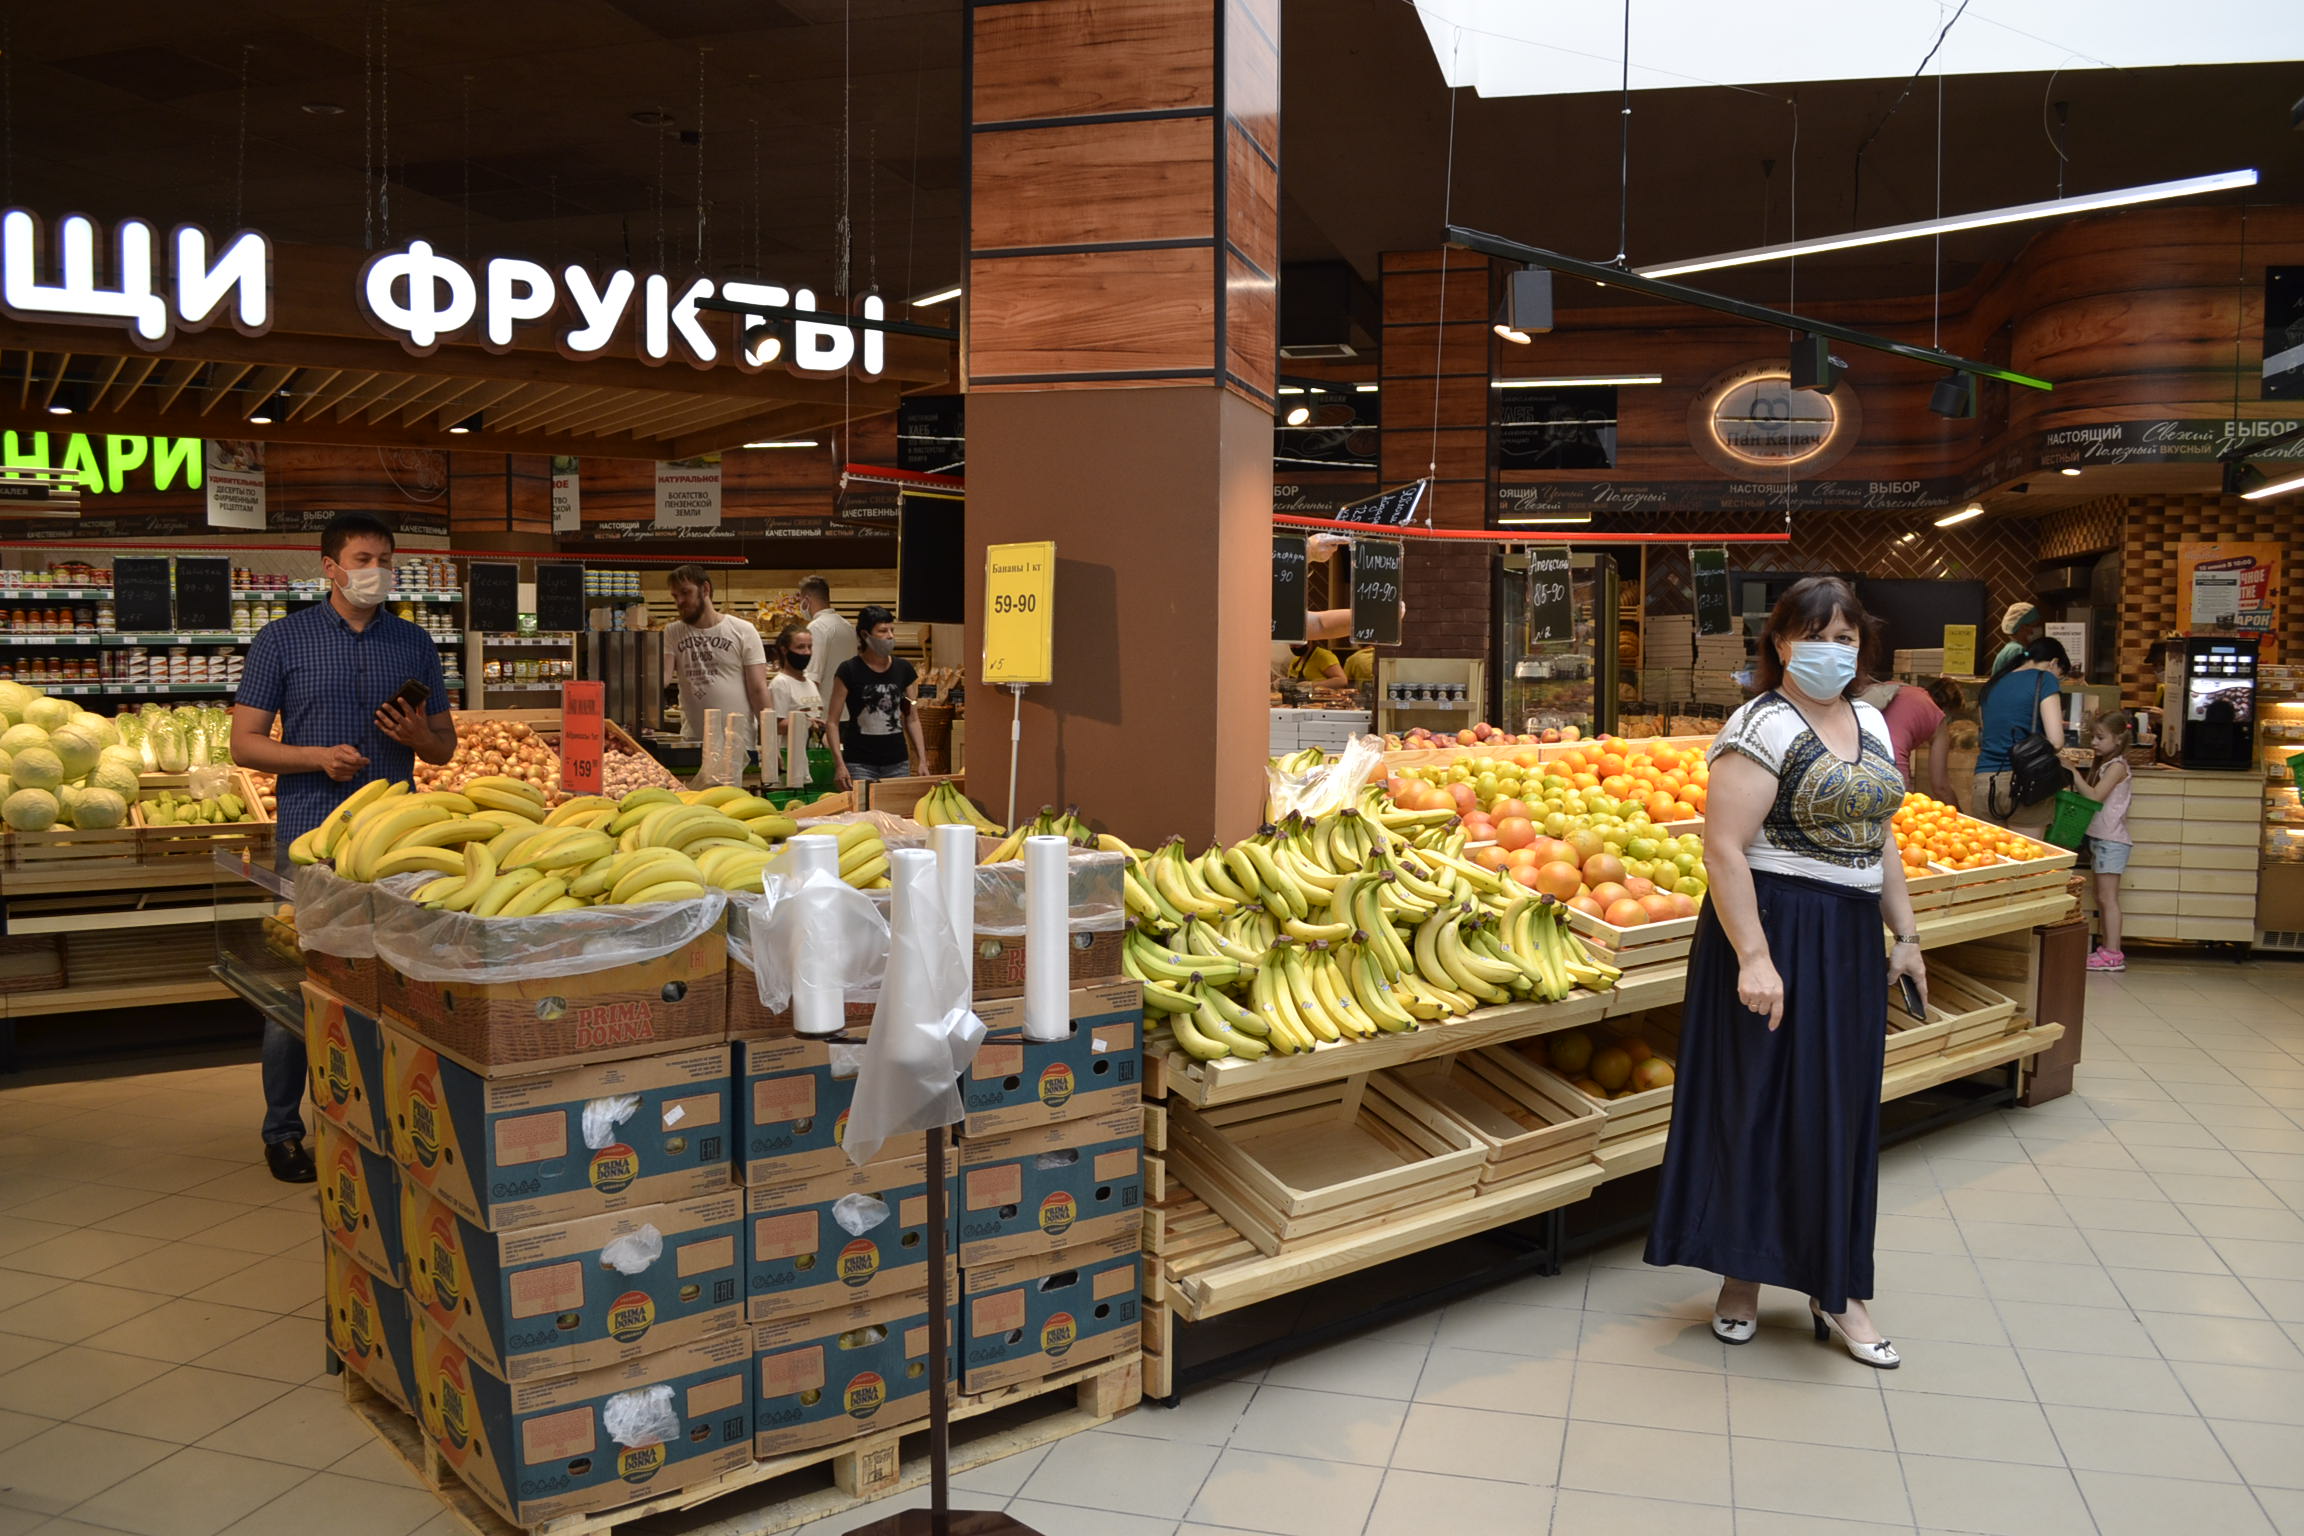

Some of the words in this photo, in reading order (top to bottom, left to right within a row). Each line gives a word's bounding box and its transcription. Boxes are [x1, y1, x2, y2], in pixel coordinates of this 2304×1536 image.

[3, 210, 267, 341] ЩИ
[366, 240, 885, 375] ФРУКТЫ
[2047, 424, 2122, 446] НАСТОЯЩИЙ
[2225, 420, 2298, 439] ВЫБОР
[2160, 444, 2212, 454] ВКУСНЫЙ
[658, 475, 720, 484] НАТУРАЛЬНОЕ
[1729, 483, 1799, 494] НАСТОЯЩИЙ
[1869, 481, 1921, 493] ВЫБОР
[668, 491, 709, 500] БОГАТСТВО
[1592, 482, 1668, 511] Полезный
[664, 499, 713, 508] ПЕНЗЕНСКОЙ
[303, 511, 335, 520] ВЫБОР
[675, 508, 702, 517] ЗЕМЛИ
[842, 508, 899, 519] КАЧЕСТВЕННЫ
[599, 520, 640, 529] НАСТОЯЩИЙ
[765, 528, 822, 537] КАЧЕСТВЕННЫЙ
[1355, 544, 1400, 570] Лимоны
[992, 563, 1024, 574] Бананы
[1357, 582, 1398, 602] 119-90
[1534, 583, 1565, 606] 85-90
[994, 593, 1036, 613] 59-90
[678, 636, 732, 653] CUSTOM
[573, 759, 592, 778] 159
[578, 1000, 653, 1028] PRIMA
[575, 1021, 654, 1048] DONNA
[1044, 1076, 1068, 1088] PRIMA
[1044, 1083, 1069, 1095] DONNA
[597, 1158, 630, 1172] PRIMA
[597, 1167, 631, 1180] DONNA
[1045, 1205, 1070, 1217] PRIMA
[1045, 1212, 1071, 1223] DONNA
[844, 1253, 872, 1266] PRIMA
[844, 1261, 873, 1274] DONNA
[615, 1307, 646, 1321] PRIMA
[615, 1316, 647, 1330] DONNA
[1047, 1326, 1070, 1339] PRIMA
[1047, 1333, 1071, 1345] DONNA
[850, 1386, 878, 1399] PRIMA
[851, 1394, 879, 1406] DONNA
[625, 1448, 656, 1463] PRIMA
[625, 1456, 658, 1471] DONNA
